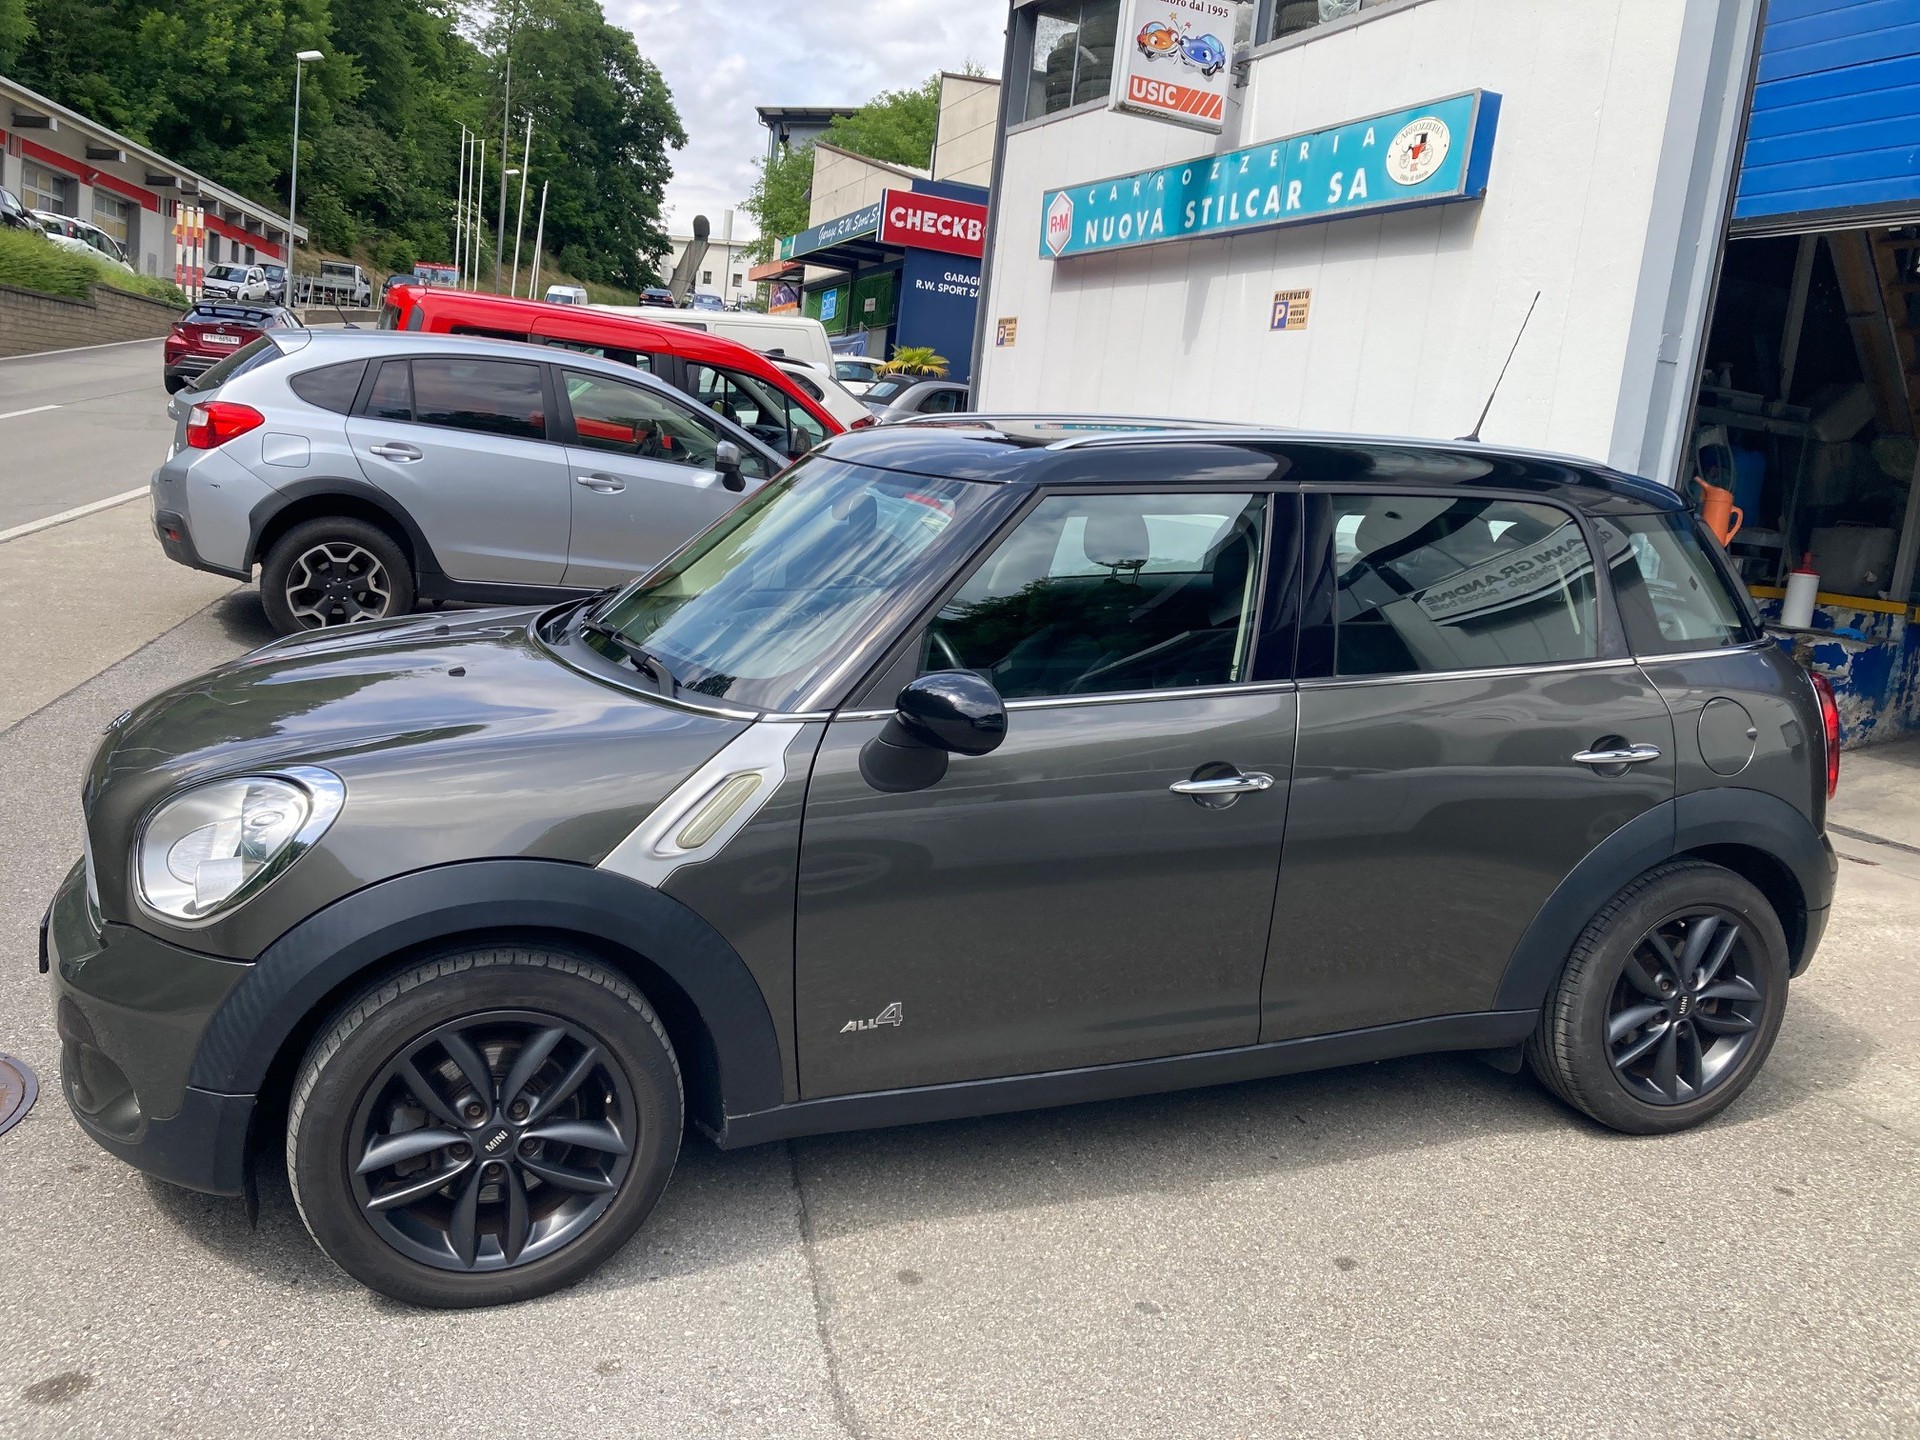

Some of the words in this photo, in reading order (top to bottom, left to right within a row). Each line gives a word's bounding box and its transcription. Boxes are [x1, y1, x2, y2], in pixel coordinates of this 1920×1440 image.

[1189, 0, 1204, 12] dal
[1207, 5, 1228, 18] 1995
[1132, 78, 1177, 106] USIC
[1084, 207, 1164, 245] NUOVA
[1184, 179, 1303, 229] STILCAR
[1327, 167, 1368, 204] SA
[889, 206, 986, 241] CHECKB
[915, 279, 936, 291] R.W.
[937, 283, 968, 296] SPORT
[1274, 290, 1310, 301] RISERVATO
[1273, 304, 1286, 327] P
[1679, 996, 1688, 1014] MINI
[840, 1001, 904, 1033] ALL4
[484, 1130, 508, 1152] MINI
